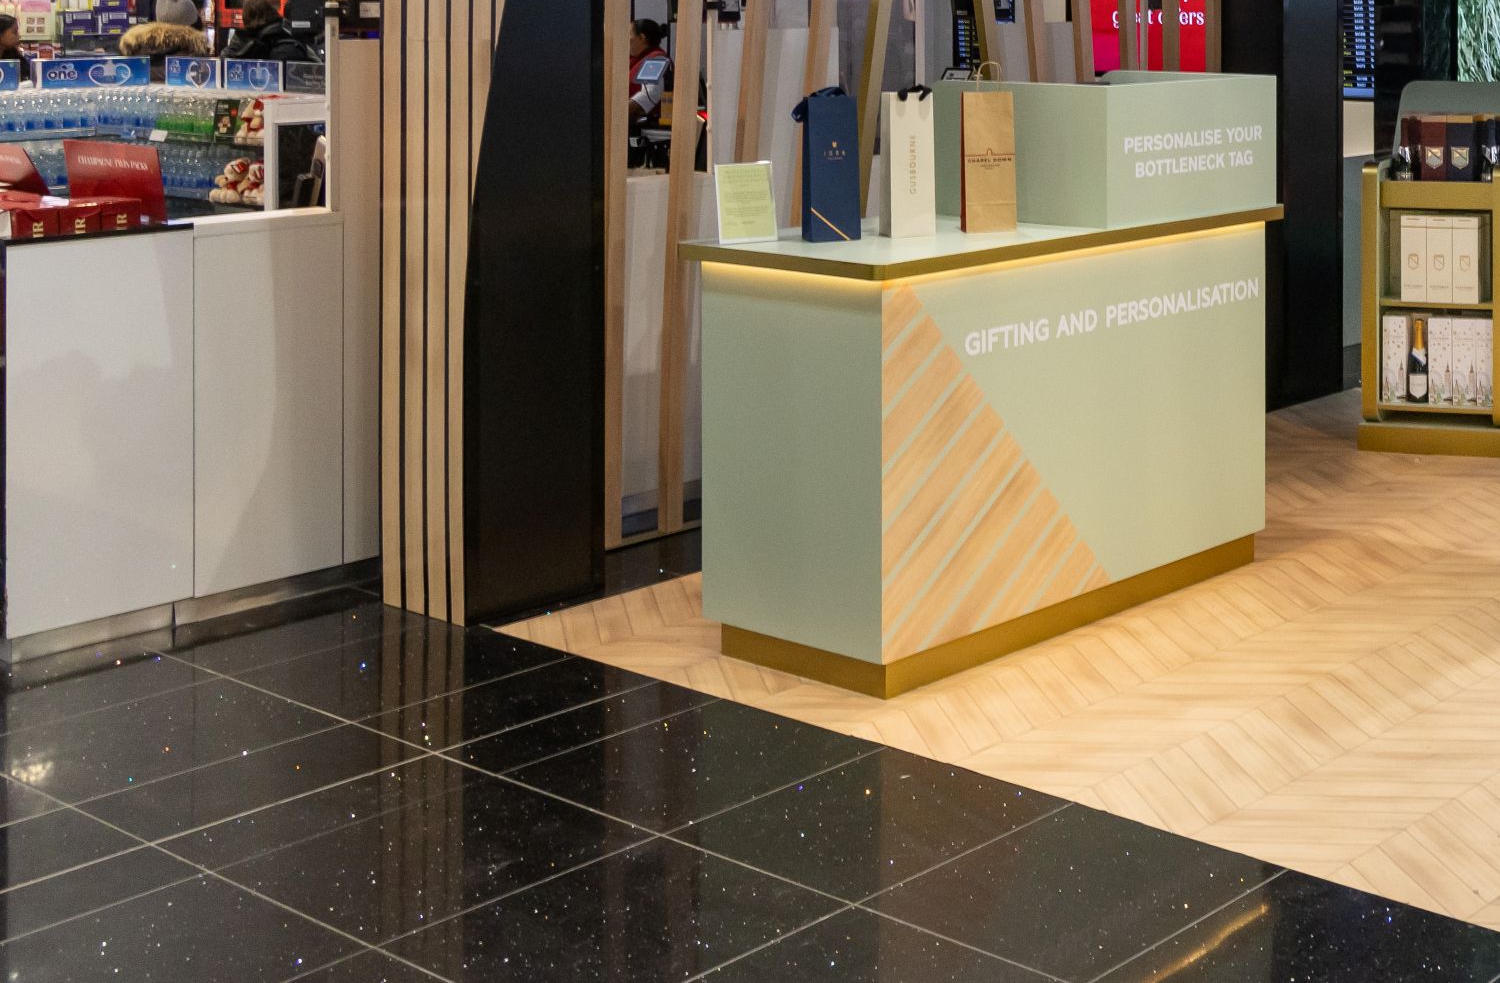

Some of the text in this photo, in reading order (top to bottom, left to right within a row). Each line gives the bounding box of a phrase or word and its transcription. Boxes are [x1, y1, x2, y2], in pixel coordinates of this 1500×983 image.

[1124, 125, 1263, 154] PERSONALISE YOUR
[1135, 150, 1253, 178] BOTTLENECK TAG
[964, 277, 1260, 357] GIFTING AND PERSONALISATION
